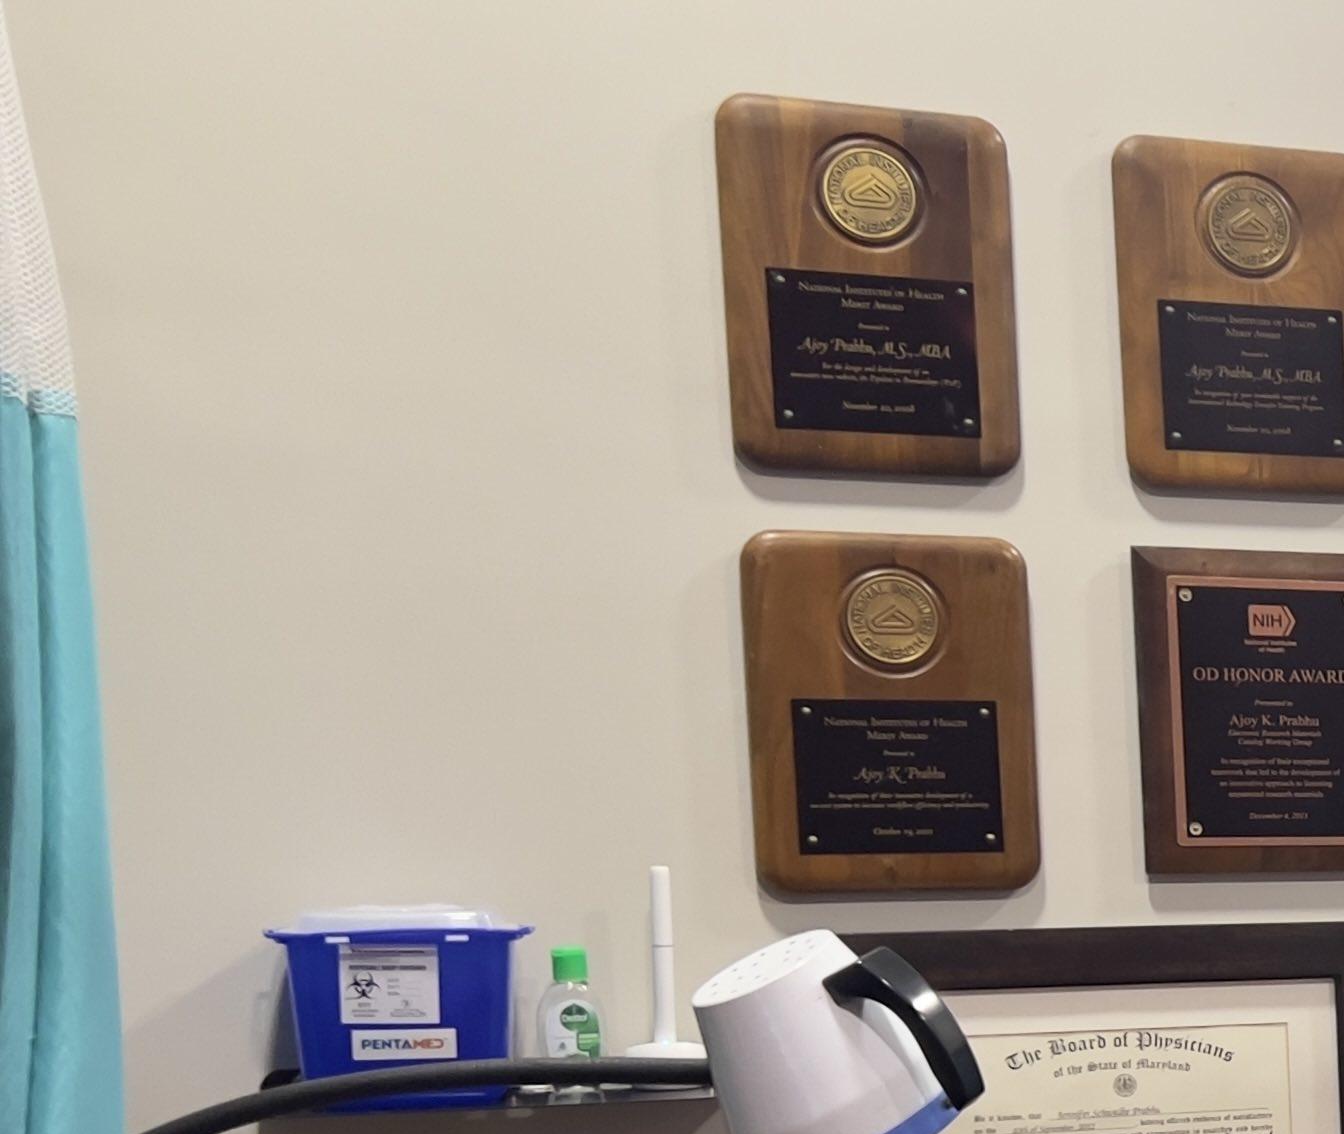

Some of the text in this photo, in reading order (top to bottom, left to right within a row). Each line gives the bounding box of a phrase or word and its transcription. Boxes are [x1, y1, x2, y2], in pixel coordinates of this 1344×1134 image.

[1252, 613, 1283, 628] NIH
[1192, 667, 1220, 682] OD
[1223, 667, 1286, 683] HONOR
[1229, 714, 1320, 728] Ajoy K. Prabhu
[361, 1038, 444, 1050] PENTAMED
[1004, 1031, 1236, 1071] The Board of Physicians
[1053, 1058, 1192, 1079] of the State of Maryland
